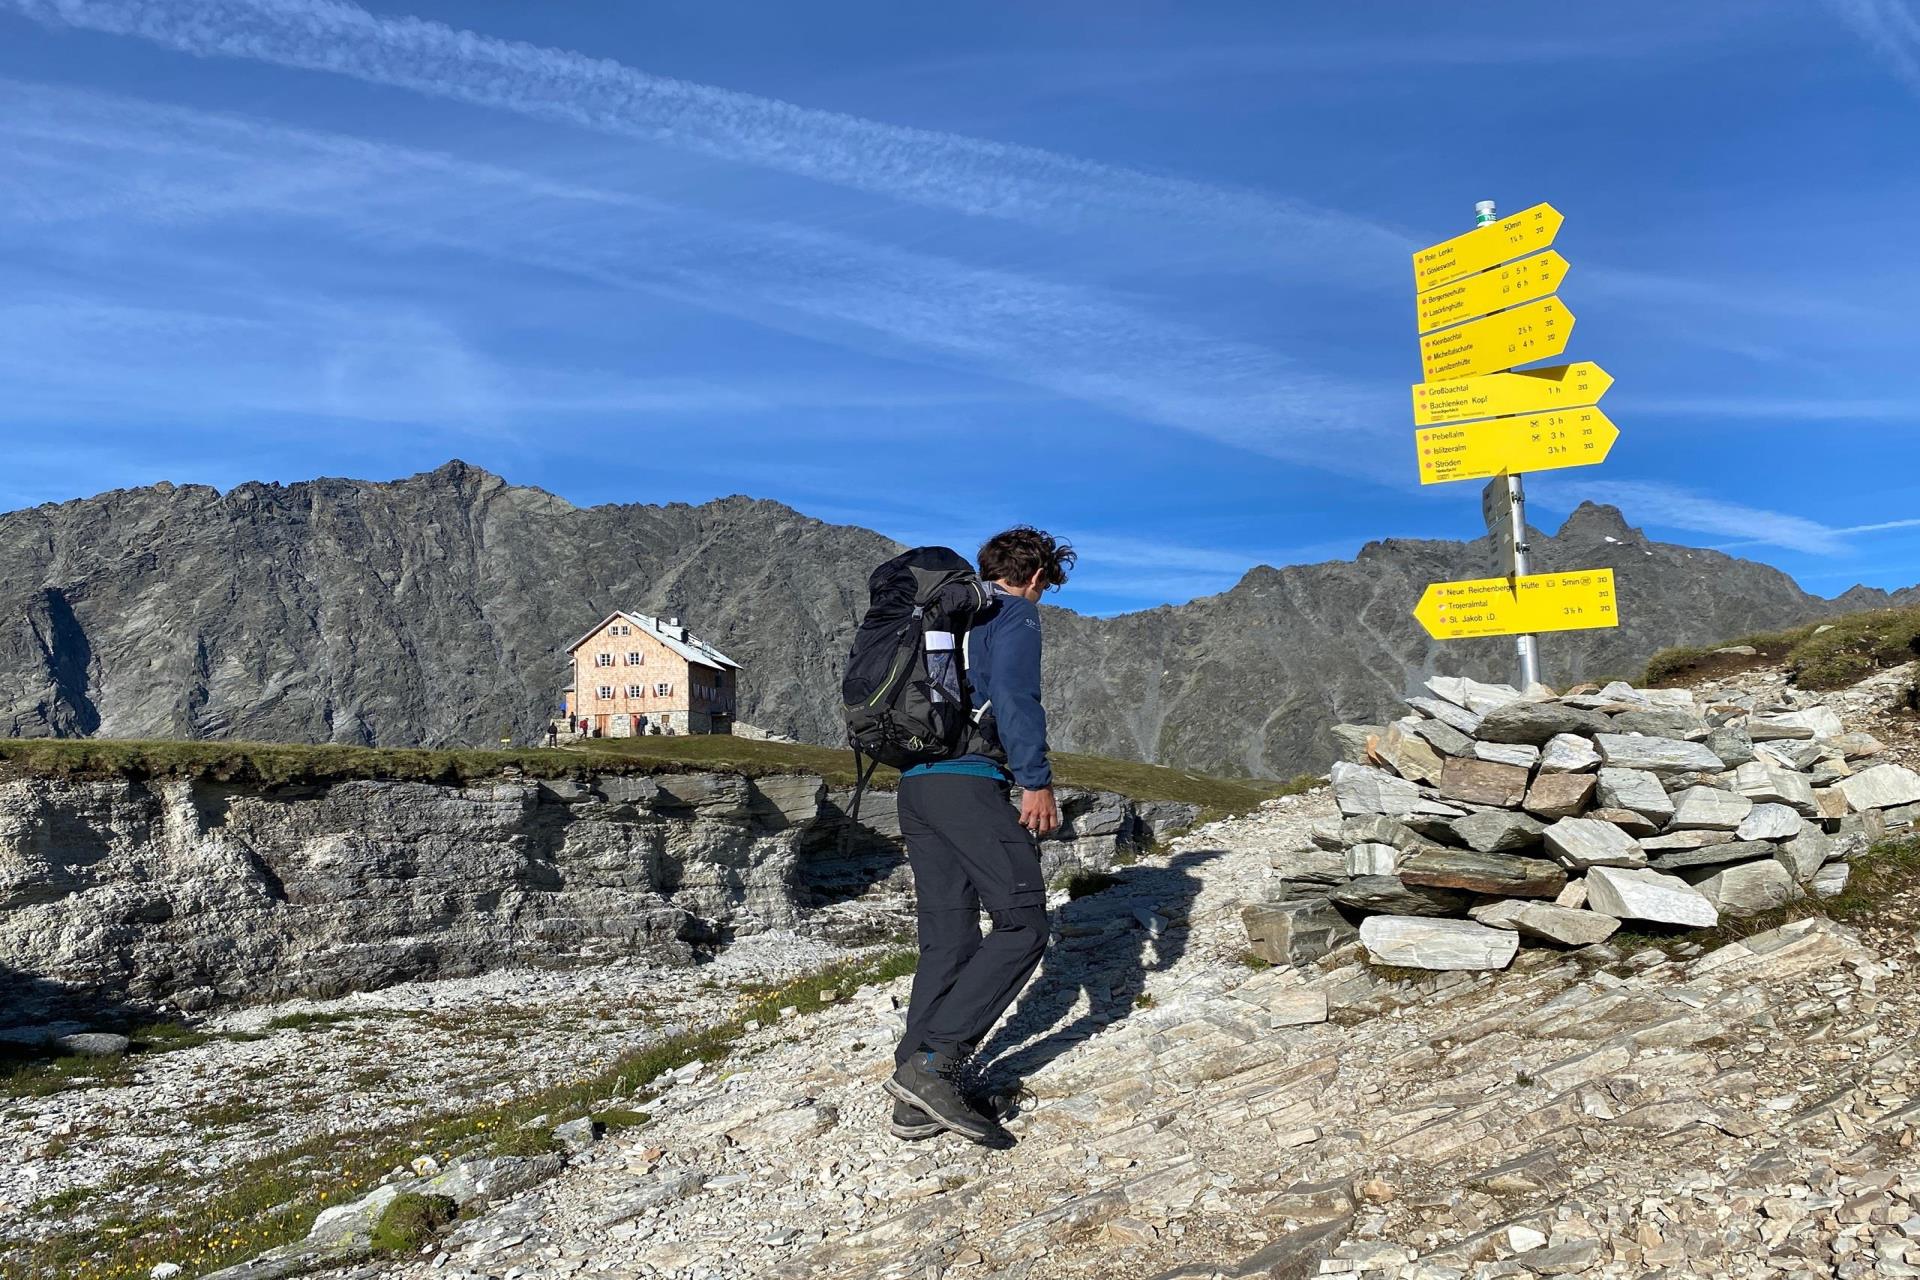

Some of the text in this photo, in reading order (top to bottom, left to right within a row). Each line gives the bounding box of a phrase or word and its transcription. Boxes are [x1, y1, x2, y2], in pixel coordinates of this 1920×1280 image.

[1430, 399, 1468, 410] Bachlenken
[1471, 395, 1488, 405] Kopf
[1549, 417, 1555, 426] 3
[1558, 416, 1563, 424] h
[1551, 431, 1556, 440] 3
[1561, 444, 1567, 453] h
[1446, 588, 1465, 596] Neue
[1562, 578, 1580, 586] 5min
[1462, 614, 1483, 623] Jakob
[1577, 606, 1583, 614] h
